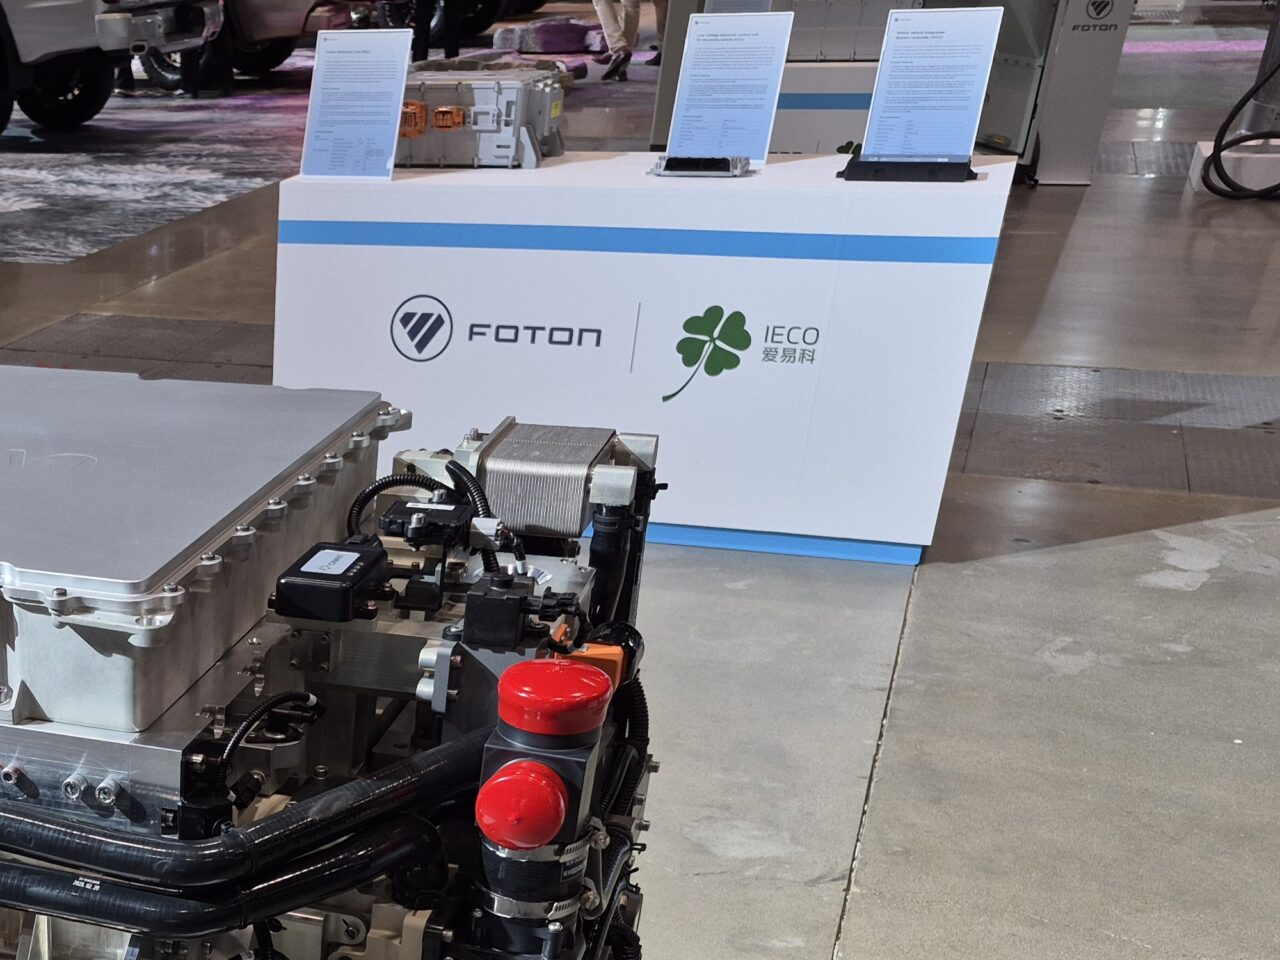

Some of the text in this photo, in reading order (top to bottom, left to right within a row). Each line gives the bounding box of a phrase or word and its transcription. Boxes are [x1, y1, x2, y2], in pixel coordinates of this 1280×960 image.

[1072, 24, 1118, 32] FOTON
[468, 323, 602, 347] FOTON
[763, 324, 820, 346] IECO
[761, 347, 817, 365] 爱易科
